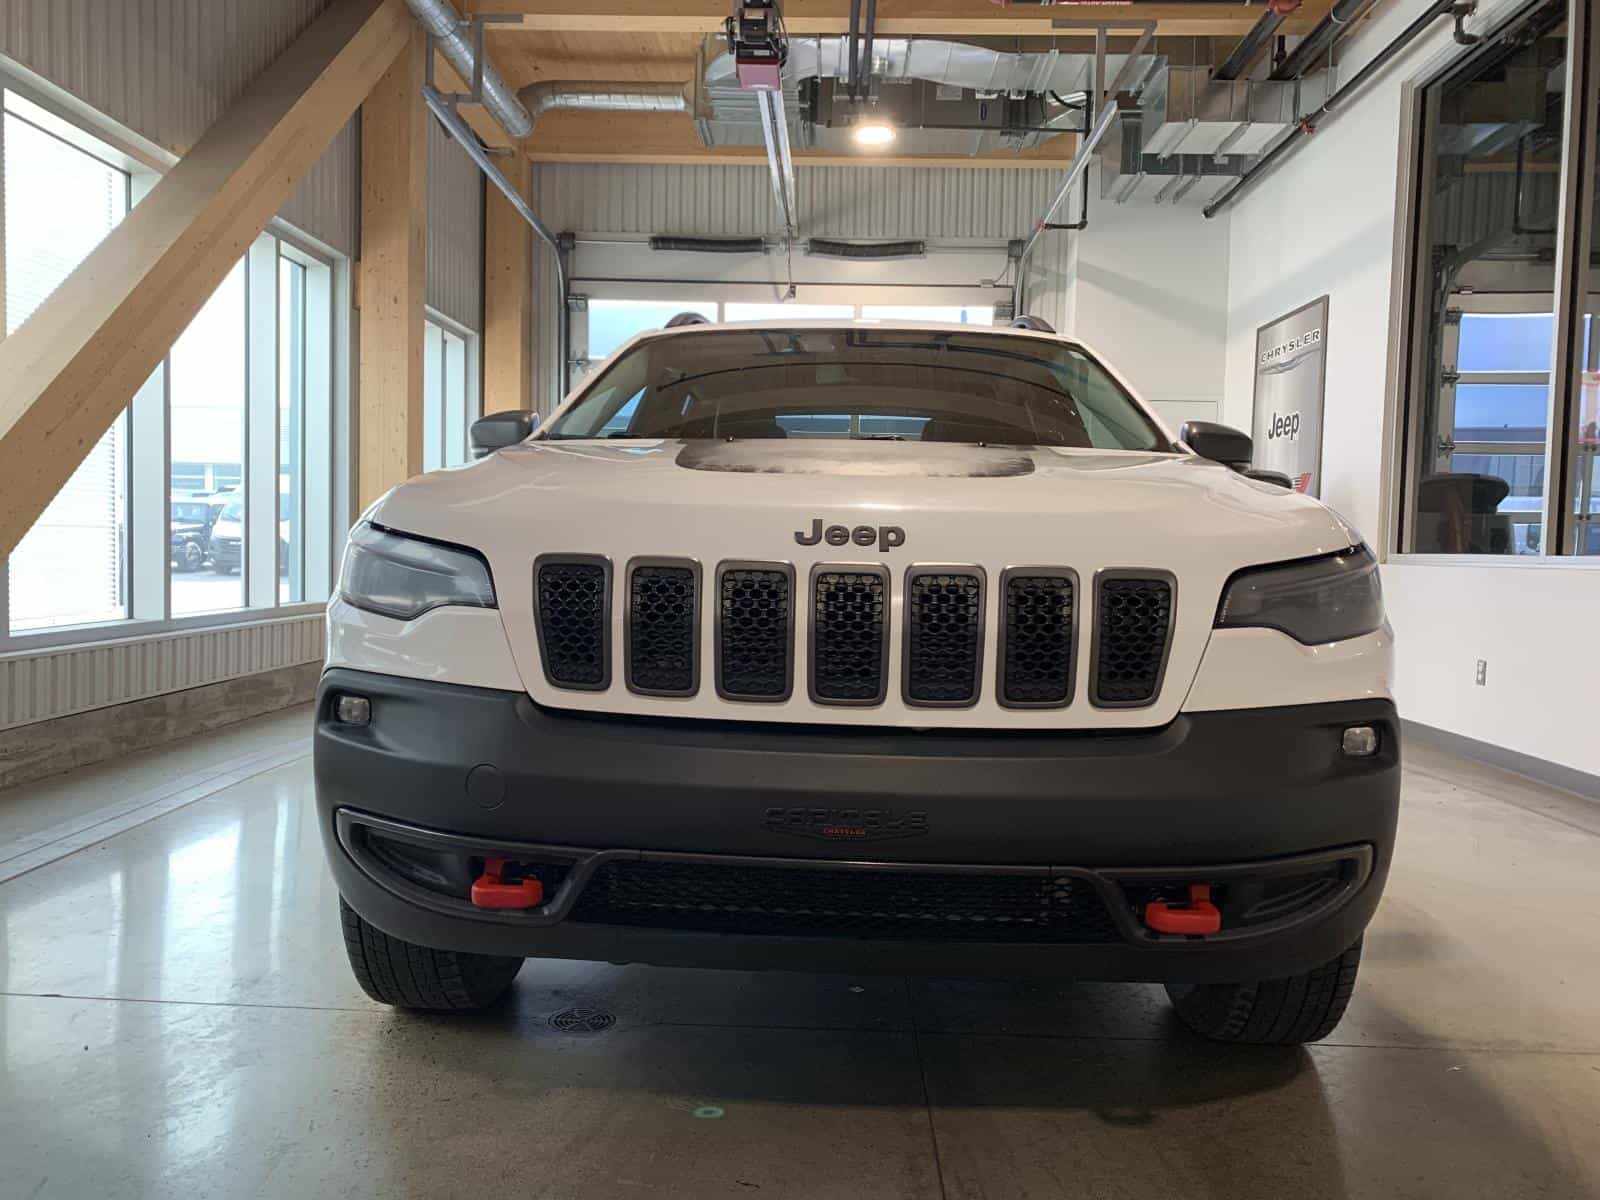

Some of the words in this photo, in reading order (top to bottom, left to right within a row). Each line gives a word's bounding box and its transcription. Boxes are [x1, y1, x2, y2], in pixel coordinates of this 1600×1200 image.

[1261, 329, 1321, 363] CHRYSLER
[1268, 412, 1300, 440] Jeep
[794, 518, 906, 552] Jeep
